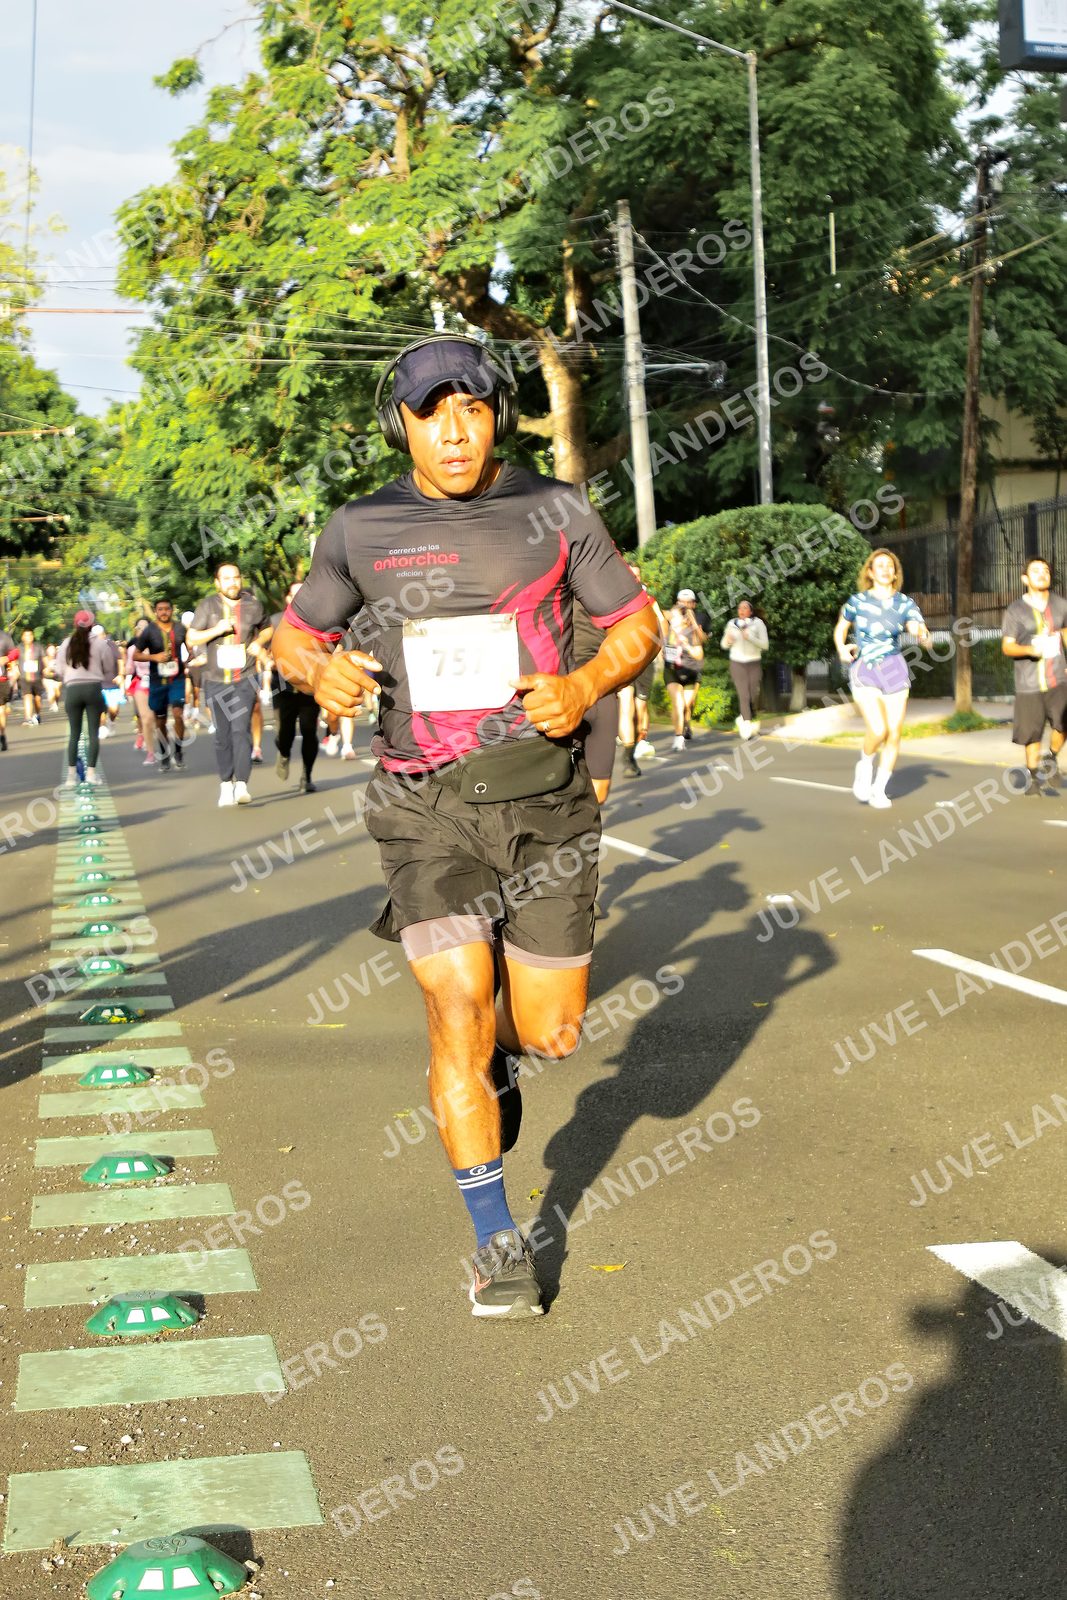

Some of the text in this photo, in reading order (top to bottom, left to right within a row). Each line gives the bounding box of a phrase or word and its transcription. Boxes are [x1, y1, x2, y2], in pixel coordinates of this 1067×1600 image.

[388, 543, 440, 556] carrera de las
[374, 552, 460, 571] antorchas
